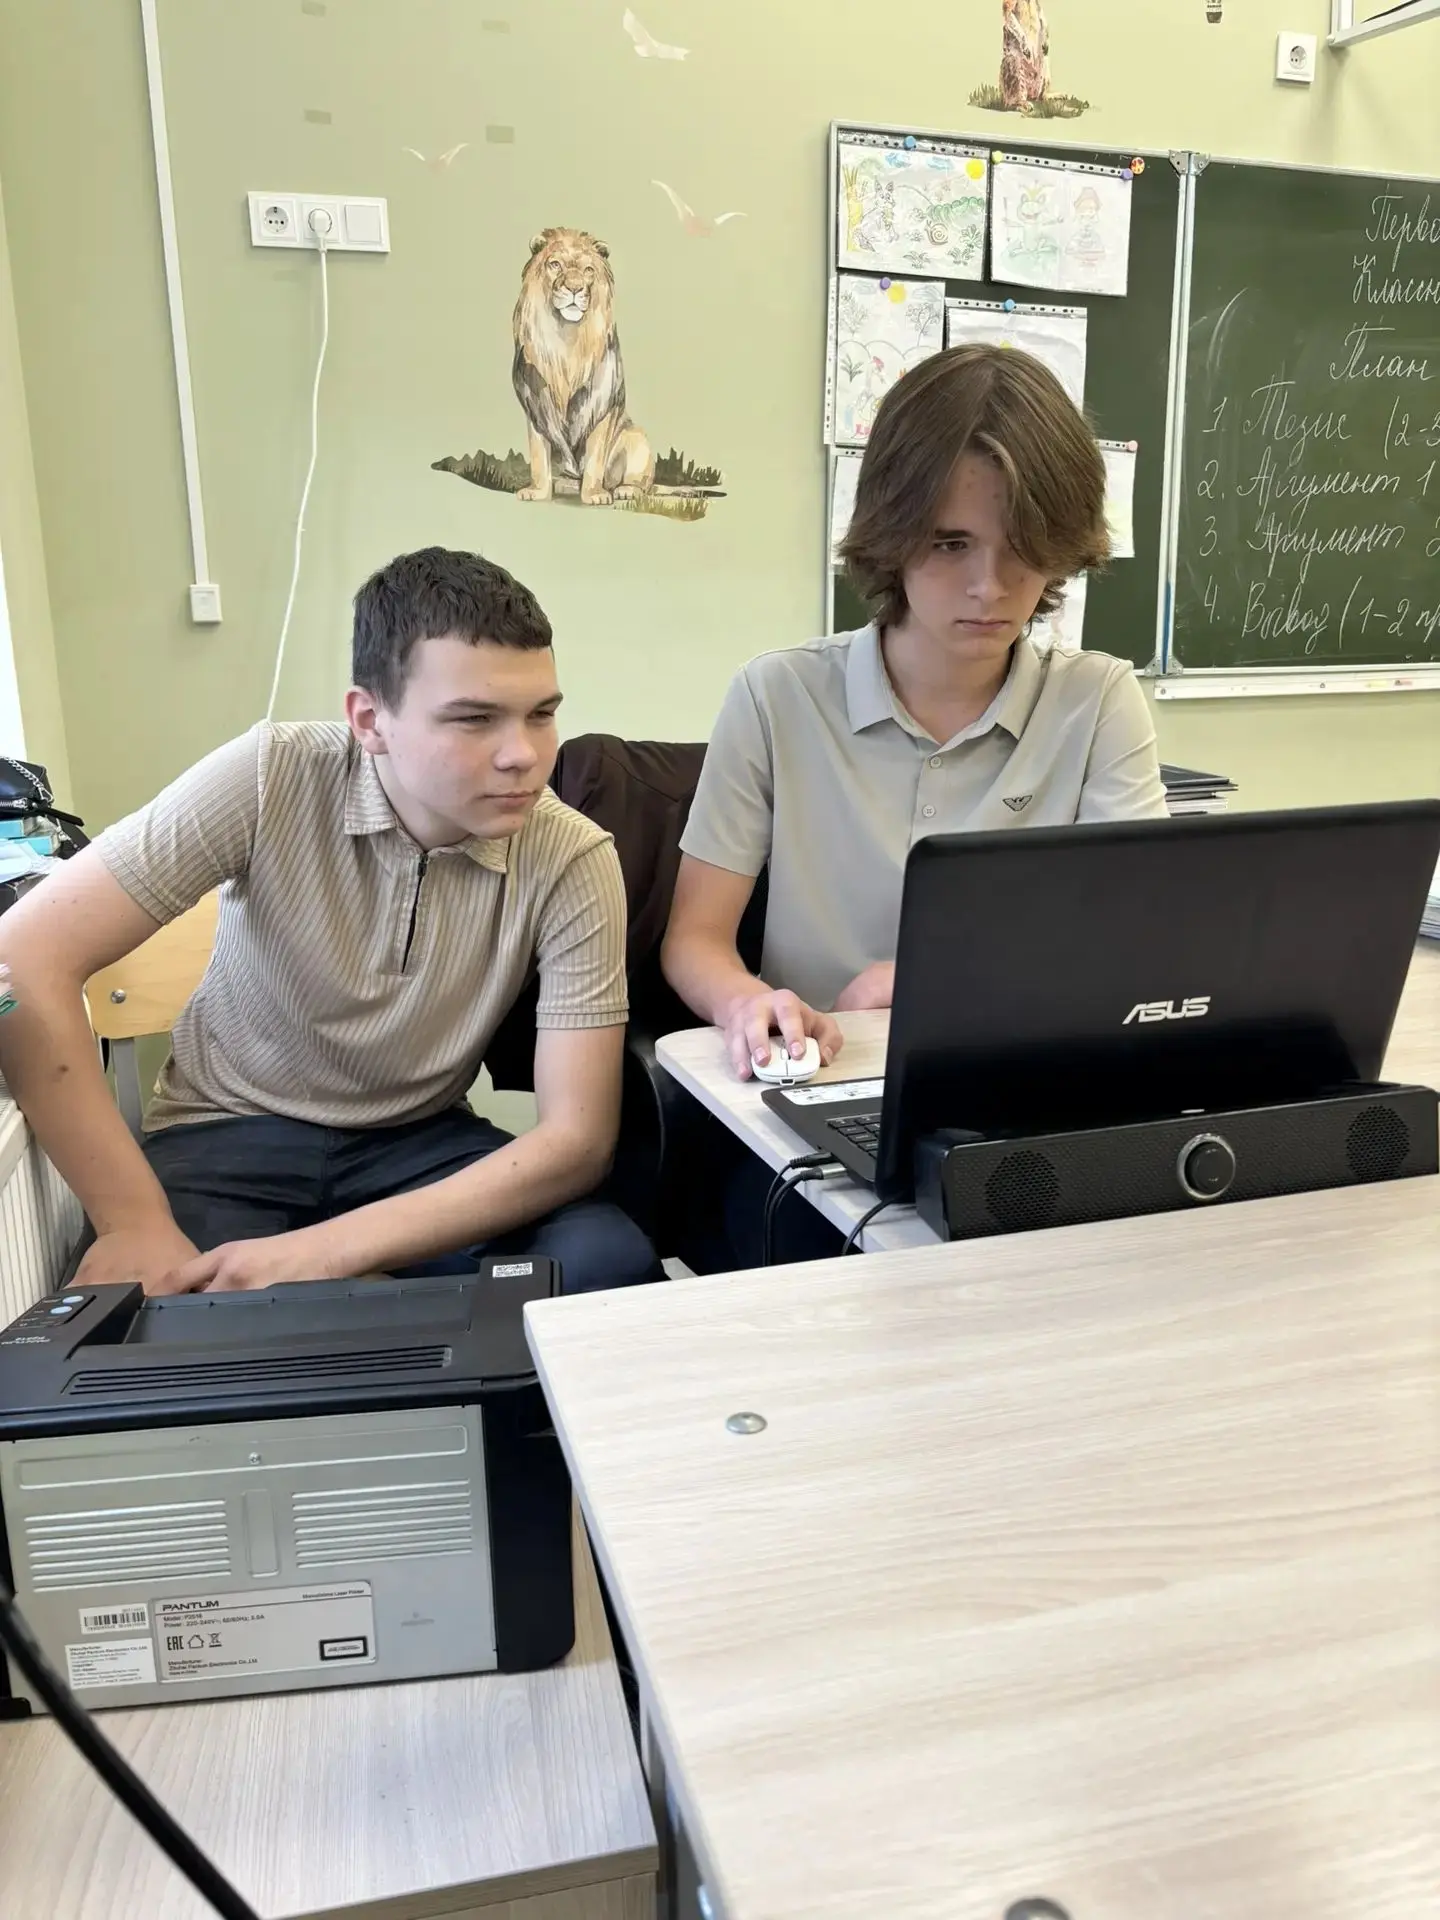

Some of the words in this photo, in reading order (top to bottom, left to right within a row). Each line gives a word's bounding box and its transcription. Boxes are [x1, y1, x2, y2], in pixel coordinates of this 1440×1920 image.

[1329, 322, 1434, 381] План
[1243, 381, 1352, 466] Тезис
[1197, 459, 1226, 499] 2.
[1236, 446, 1401, 537] Аргумент
[1417, 460, 1436, 496] 1
[1199, 516, 1222, 557] 3.
[1247, 512, 1405, 584] Аргумент
[1204, 575, 1221, 623] 4.
[1122, 996, 1211, 1025] ASUS
[162, 1600, 220, 1611] PANTUM
